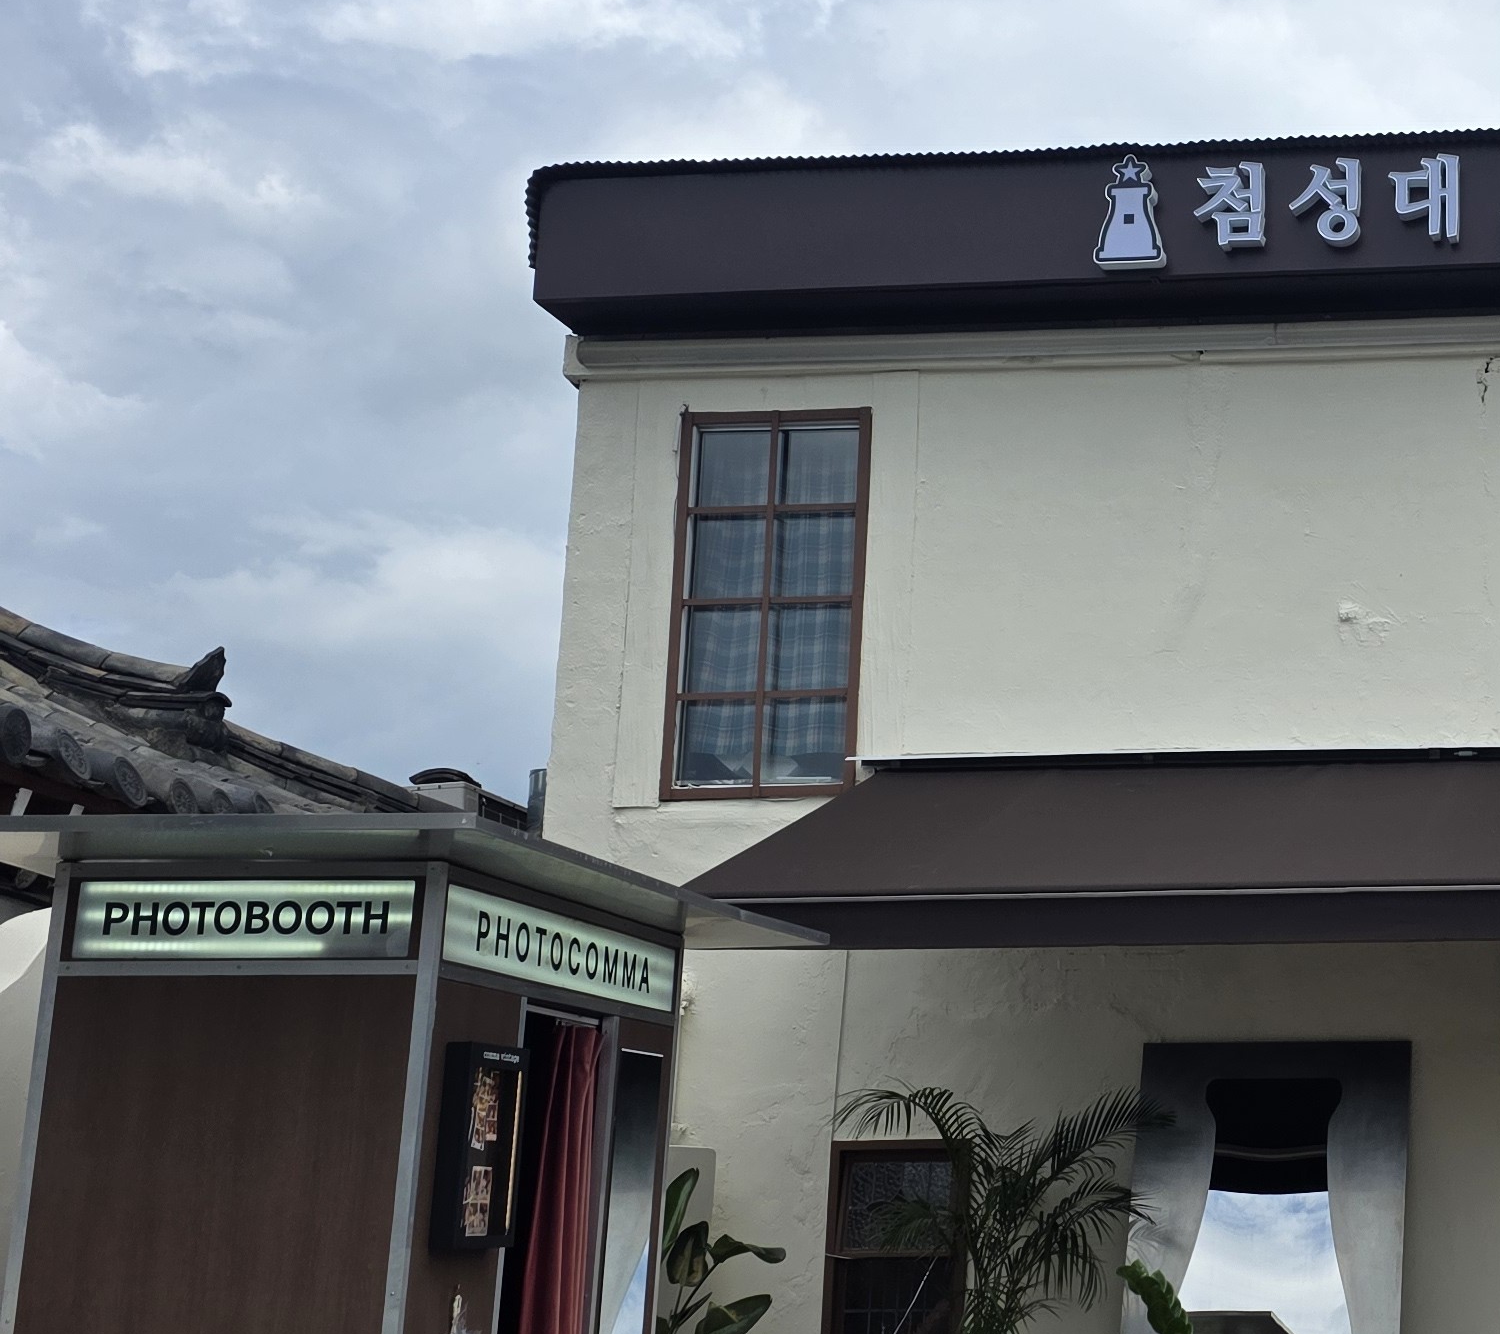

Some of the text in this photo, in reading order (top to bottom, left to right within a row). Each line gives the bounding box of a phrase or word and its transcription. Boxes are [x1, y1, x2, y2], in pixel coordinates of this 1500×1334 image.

[1194, 153, 1461, 250] 첨성대
[102, 900, 391, 936] PHOTOBOOTH
[476, 910, 652, 995] PHOTOCOMMA
